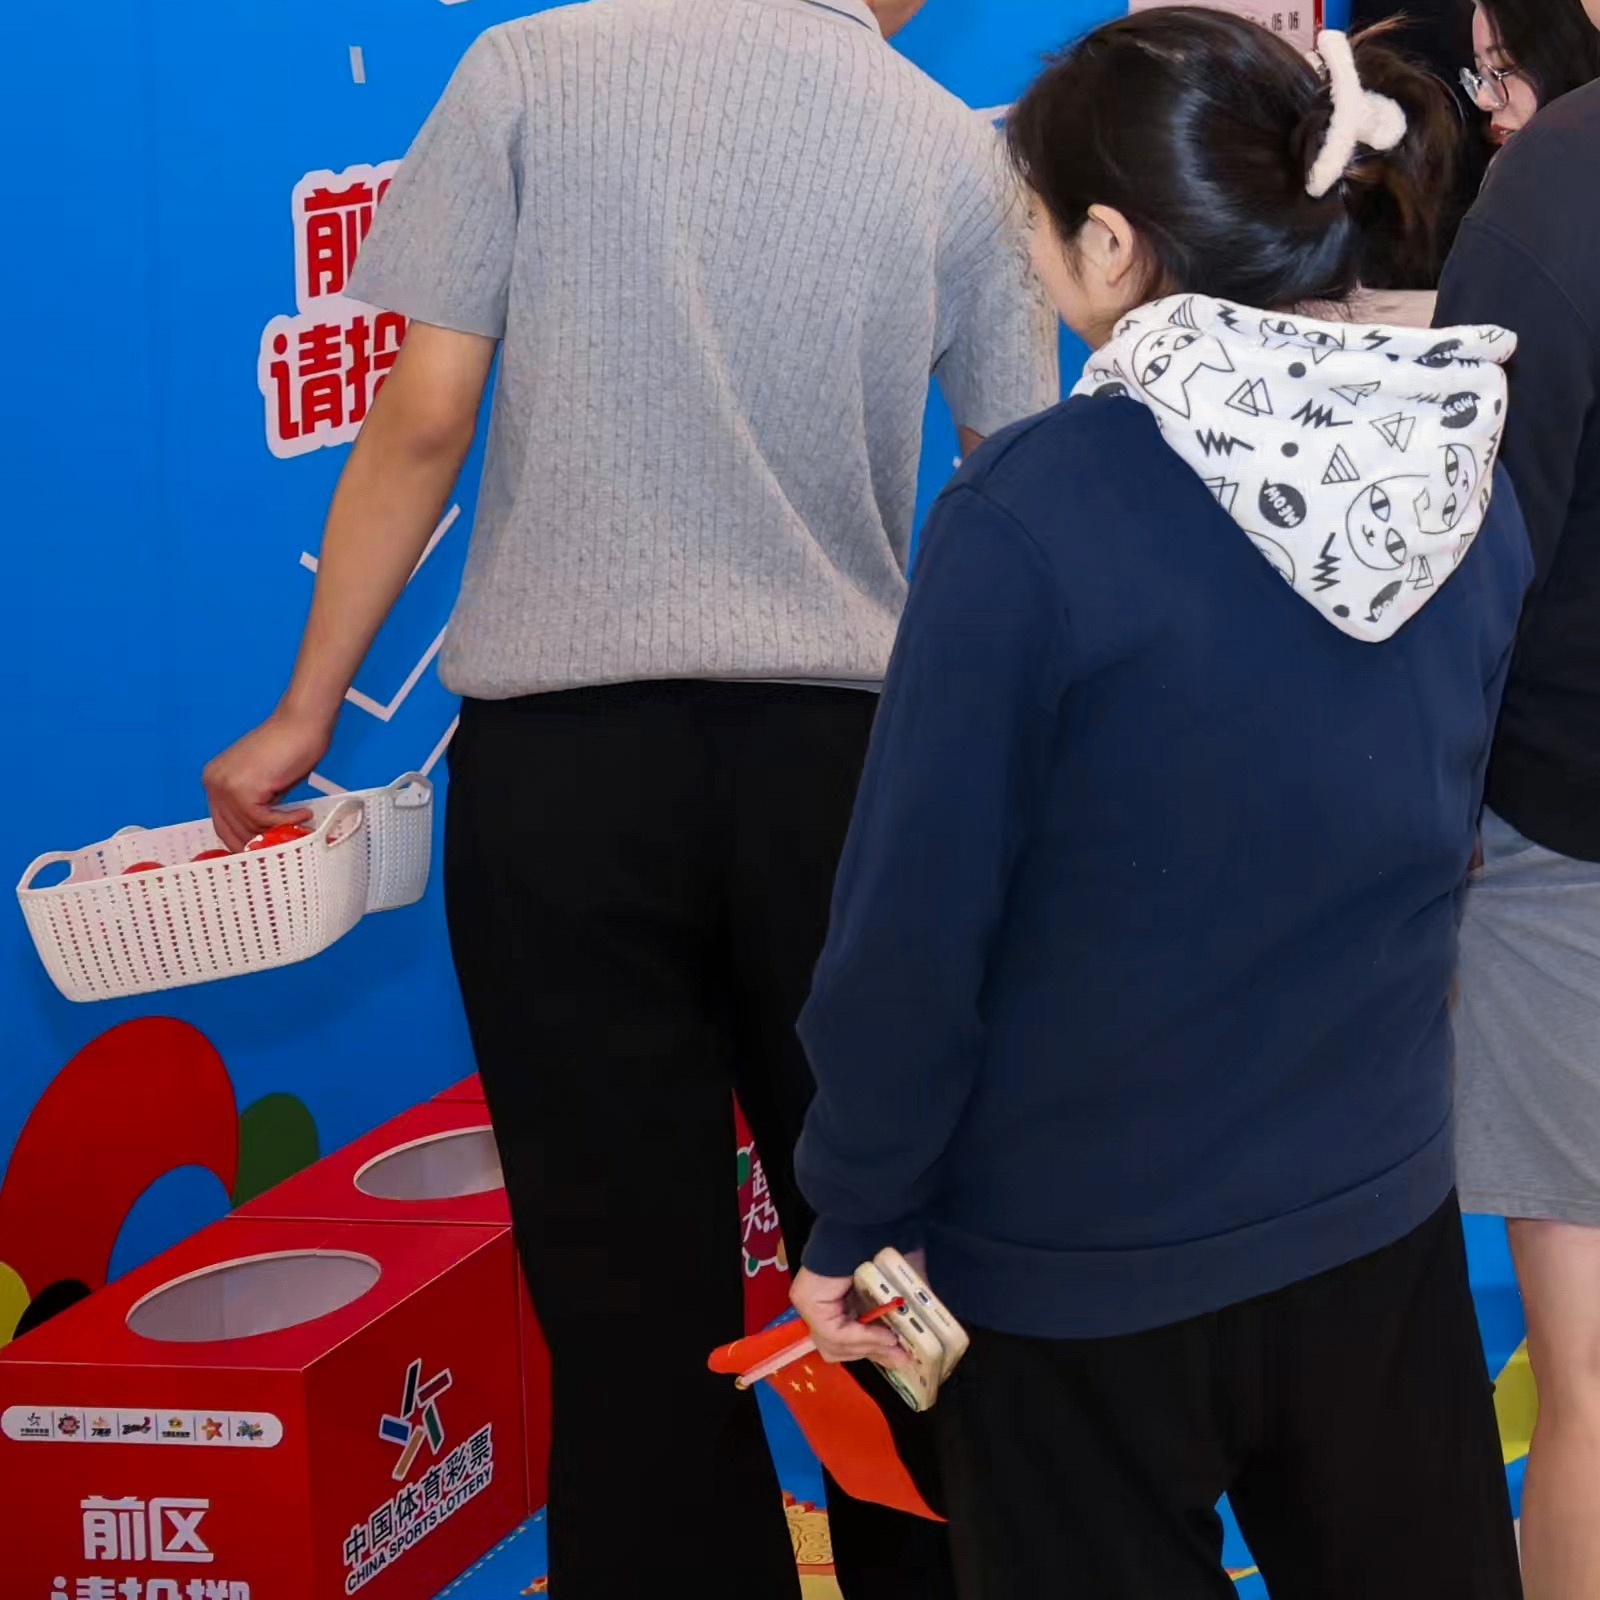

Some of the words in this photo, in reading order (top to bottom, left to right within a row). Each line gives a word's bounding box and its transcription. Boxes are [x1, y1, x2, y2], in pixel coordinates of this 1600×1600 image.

[1288, 12, 1298, 30] 06
[305, 180, 394, 299] 前
[80, 1495, 214, 1563] 前区
[345, 1425, 492, 1564] 中国体育彩票
[347, 1554, 388, 1591] CHINA
[389, 1511, 438, 1559] SPORTS
[438, 1467, 492, 1519] LOTTERY
